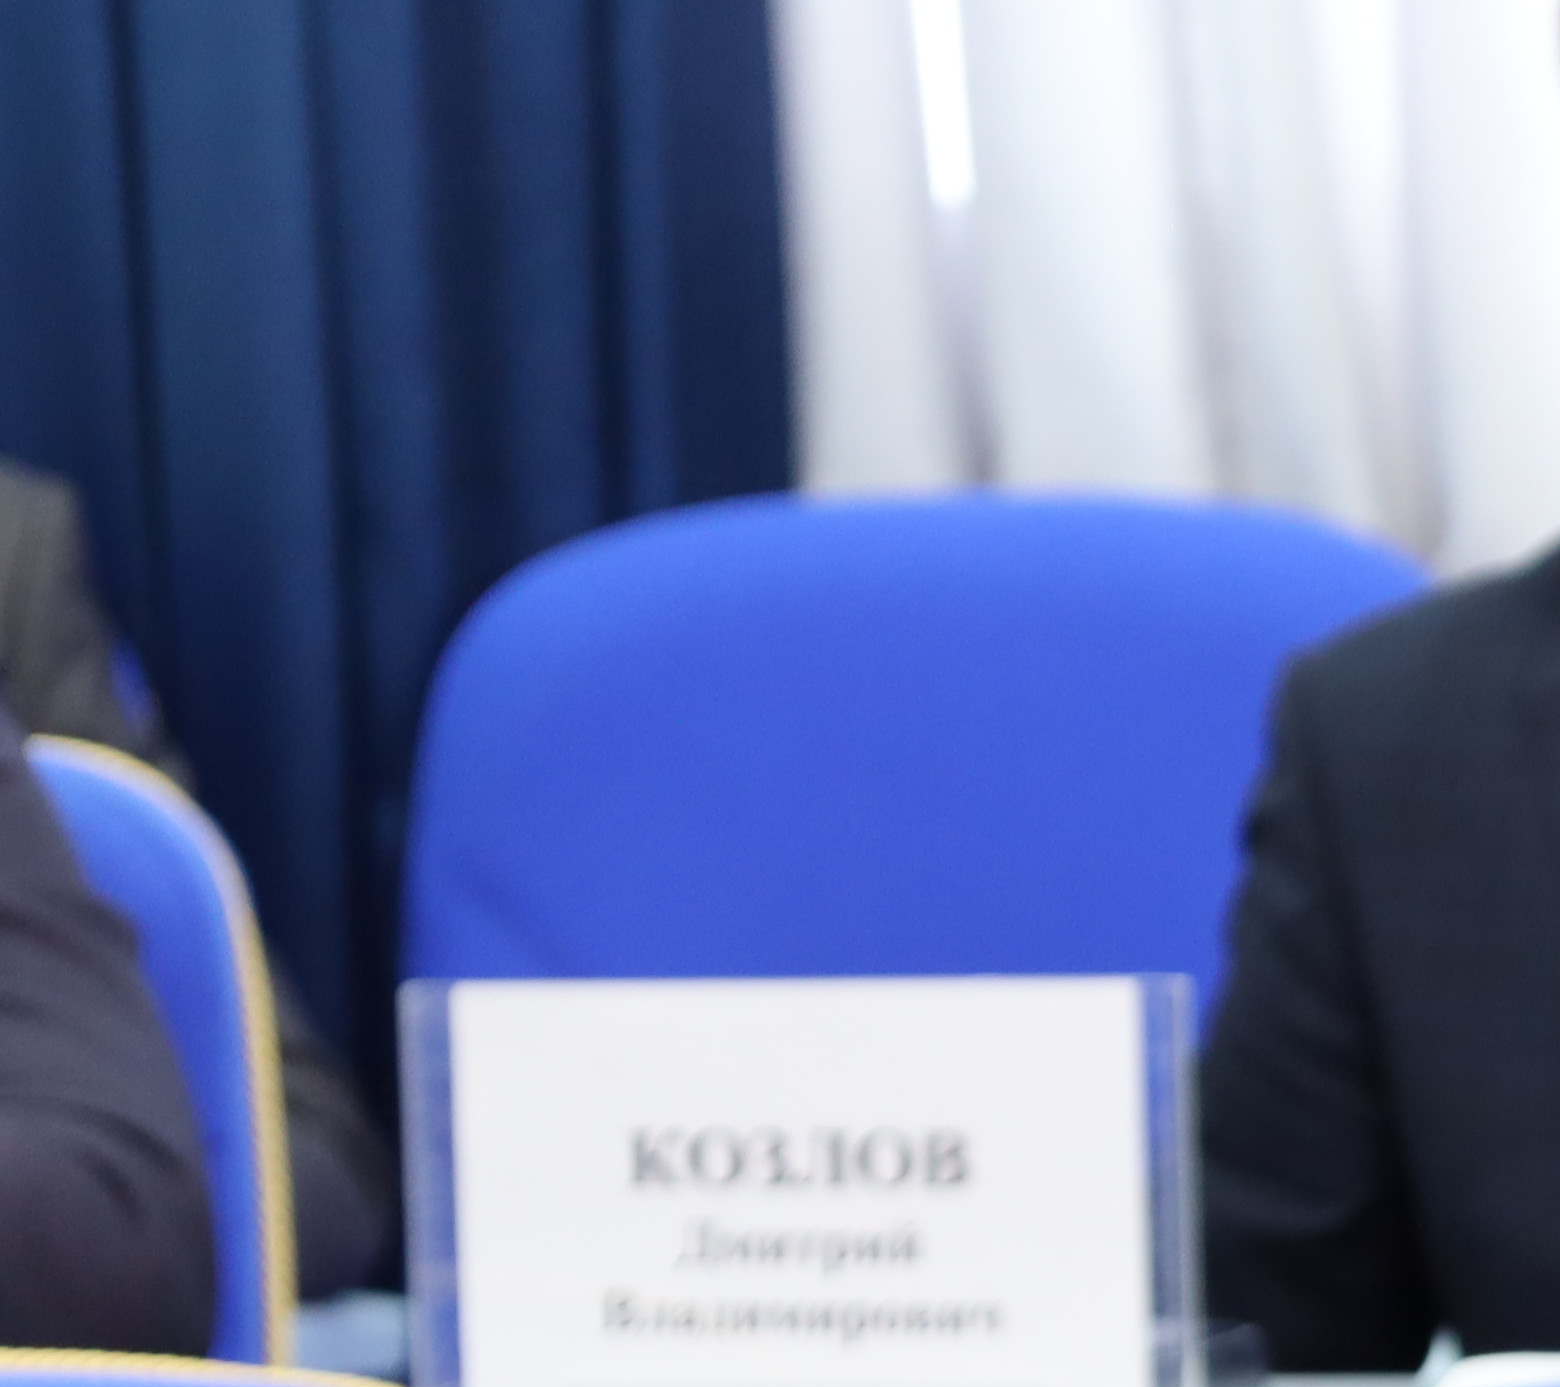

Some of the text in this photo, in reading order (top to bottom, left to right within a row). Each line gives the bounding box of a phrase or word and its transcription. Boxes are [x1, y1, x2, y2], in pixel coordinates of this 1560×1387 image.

[628, 1126, 976, 1193] КОЗЛОВ
[672, 1218, 925, 1274] Дмитрий
[602, 1289, 1006, 1342] Владимирович
